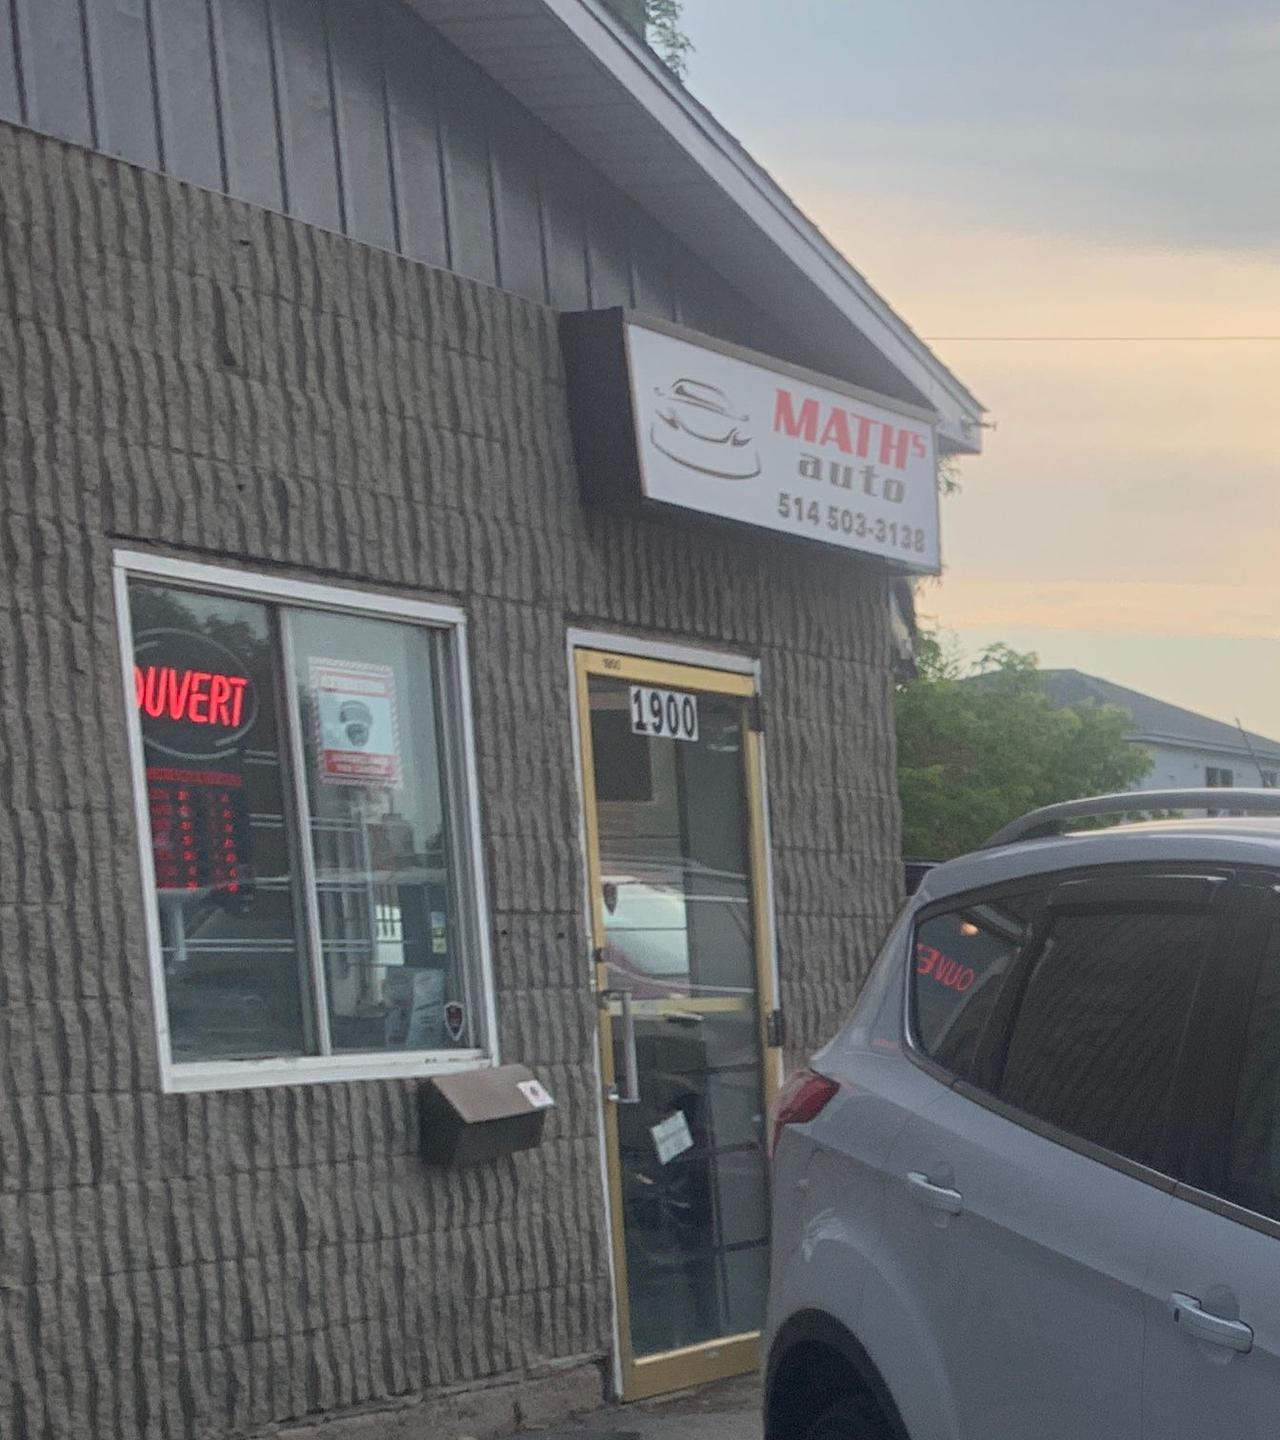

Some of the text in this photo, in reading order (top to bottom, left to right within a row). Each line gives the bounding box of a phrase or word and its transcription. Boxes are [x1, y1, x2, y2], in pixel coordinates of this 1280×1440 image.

[798, 453, 905, 503] auto
[778, 493, 925, 553] 514 503-3138
[634, 690, 694, 737] 1900
